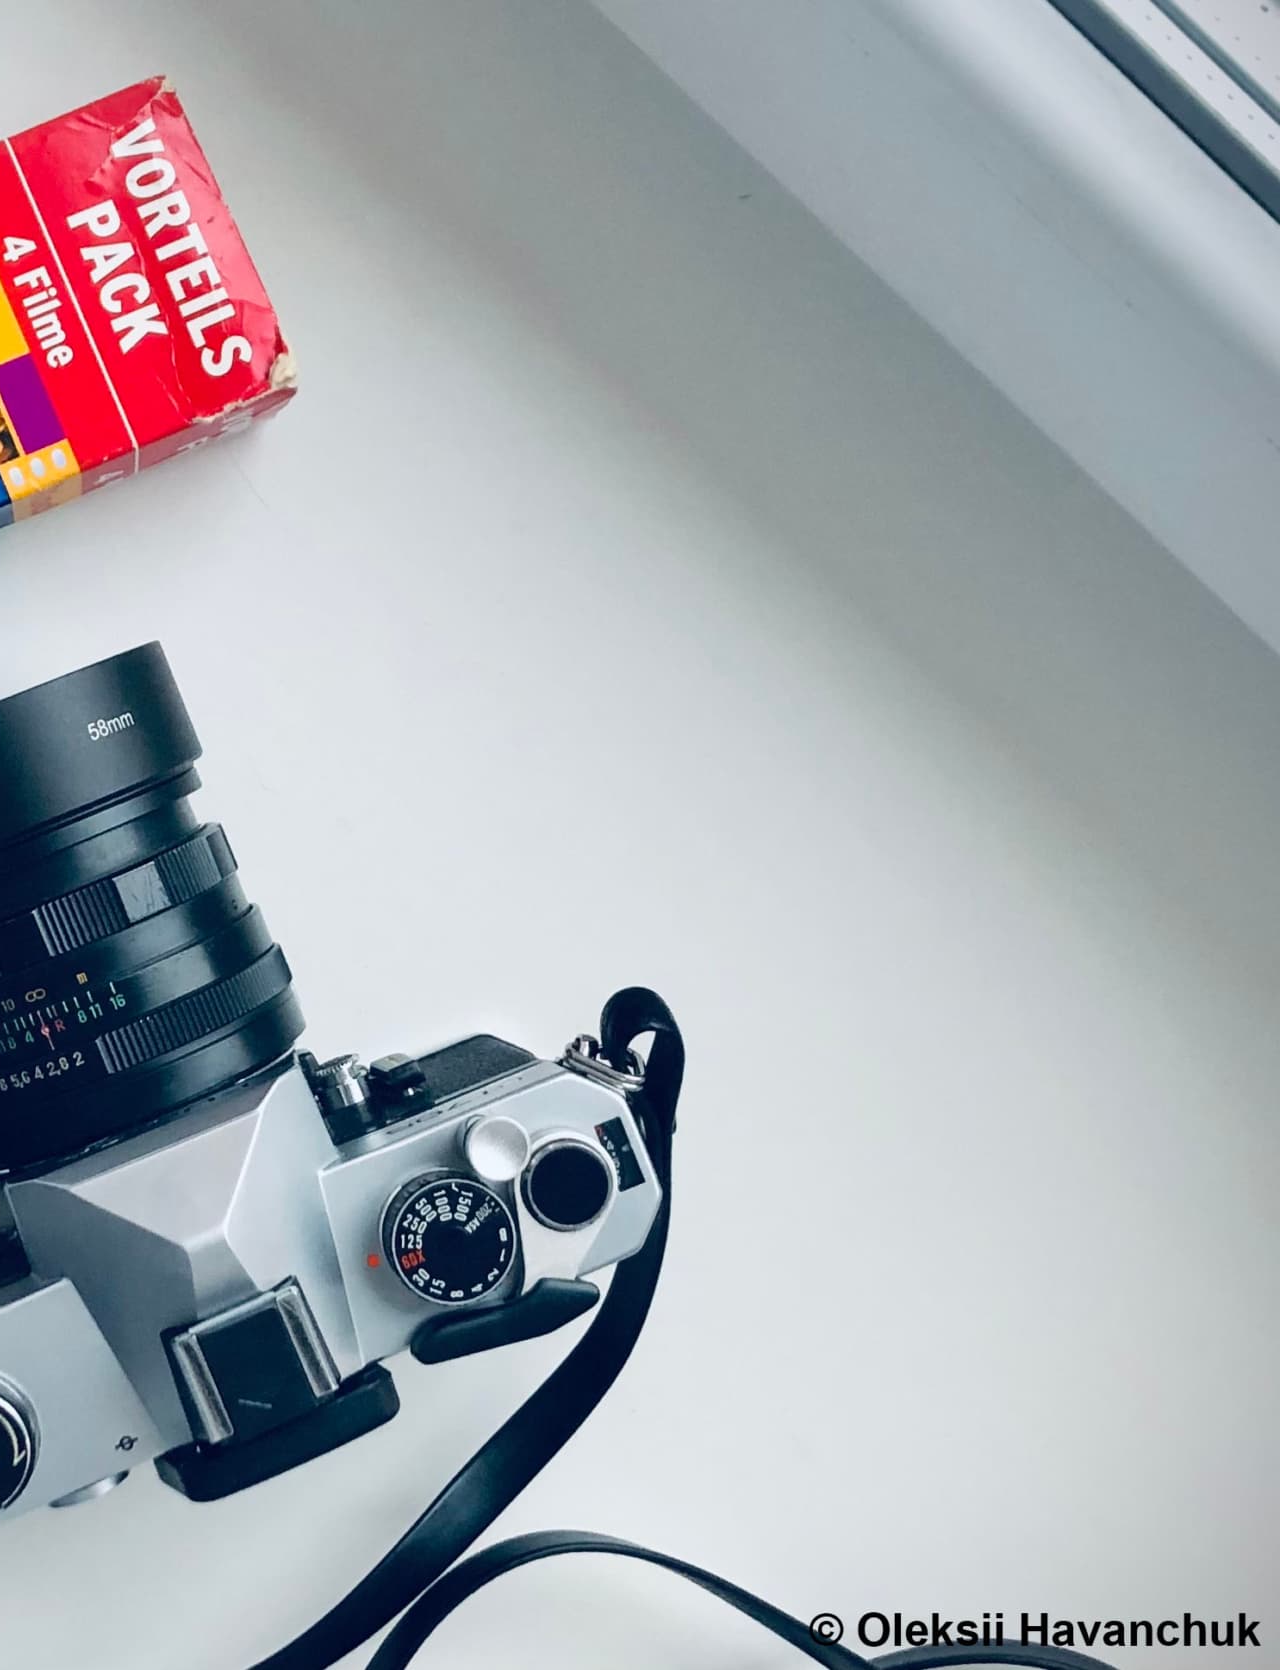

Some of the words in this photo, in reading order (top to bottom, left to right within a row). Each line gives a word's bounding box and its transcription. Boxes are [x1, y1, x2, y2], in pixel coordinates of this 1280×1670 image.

[3, 235, 37, 264] 4
[111, 118, 253, 377] VORTEILS
[66, 199, 169, 355] PACK
[14, 266, 74, 370] Filme
[87, 712, 135, 741] 58mm
[1, 998, 16, 1013] 10
[25, 1031, 35, 1043] 4
[54, 1019, 66, 1032] R
[77, 1010, 88, 1024] 8
[89, 1003, 104, 1019] 11
[109, 994, 126, 1010] 16
[34, 1065, 44, 1080] 4
[72, 1051, 85, 1067] 2
[415, 1197, 437, 1222] 500
[433, 1189, 453, 1222] 1000
[454, 1190, 473, 1222] 1500
[402, 1214, 428, 1233] 250
[401, 1235, 423, 1250] 125
[412, 1269, 430, 1287] 30
[429, 1278, 446, 1296] 15
[471, 1282, 483, 1293] 4
[488, 1267, 500, 1282] 2
[450, 1289, 464, 1299] 8
